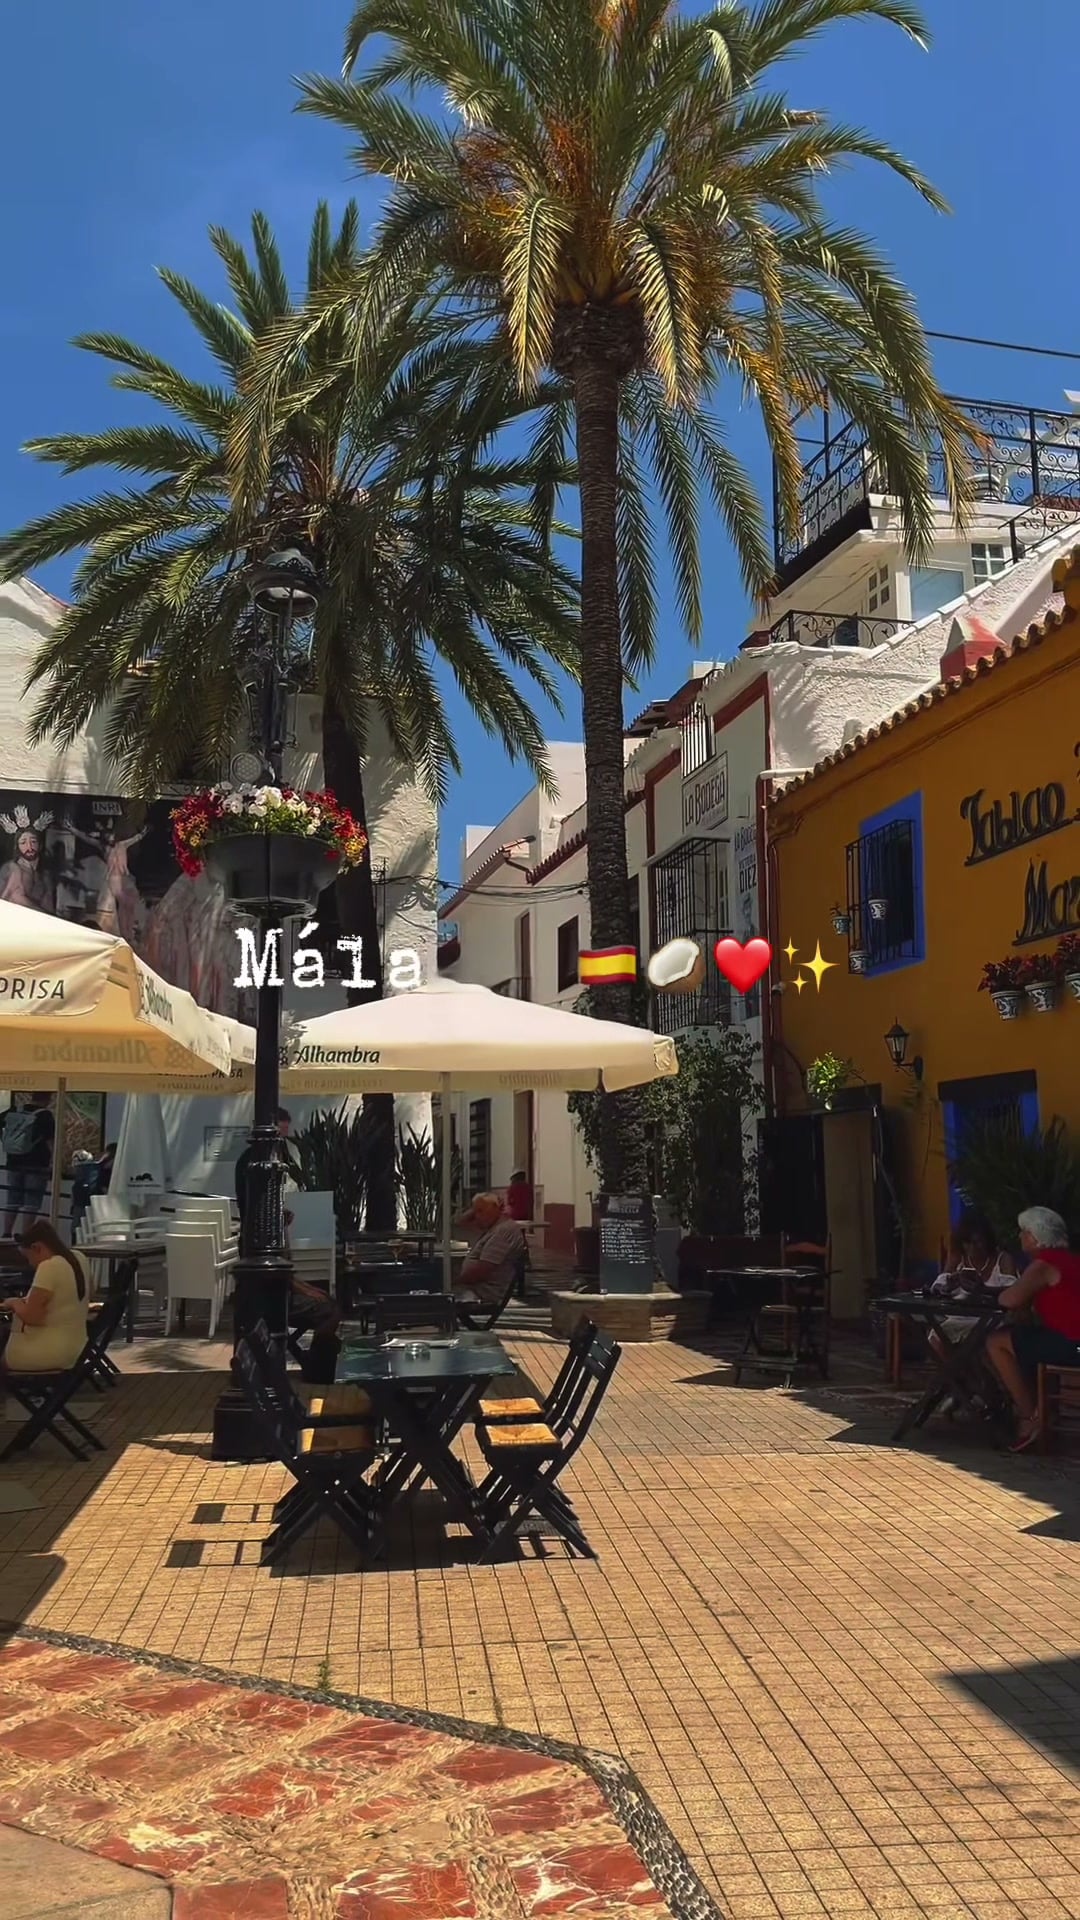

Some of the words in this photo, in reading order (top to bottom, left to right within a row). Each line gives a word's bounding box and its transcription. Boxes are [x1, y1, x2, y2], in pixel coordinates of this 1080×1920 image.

[95, 803, 119, 813] INRI
[695, 771, 725, 825] BODEGA
[960, 782, 1068, 863] Tablao
[739, 863, 757, 893] DIEZ
[0, 977, 65, 1000] PRISA
[294, 1045, 381, 1066] Alhambra
